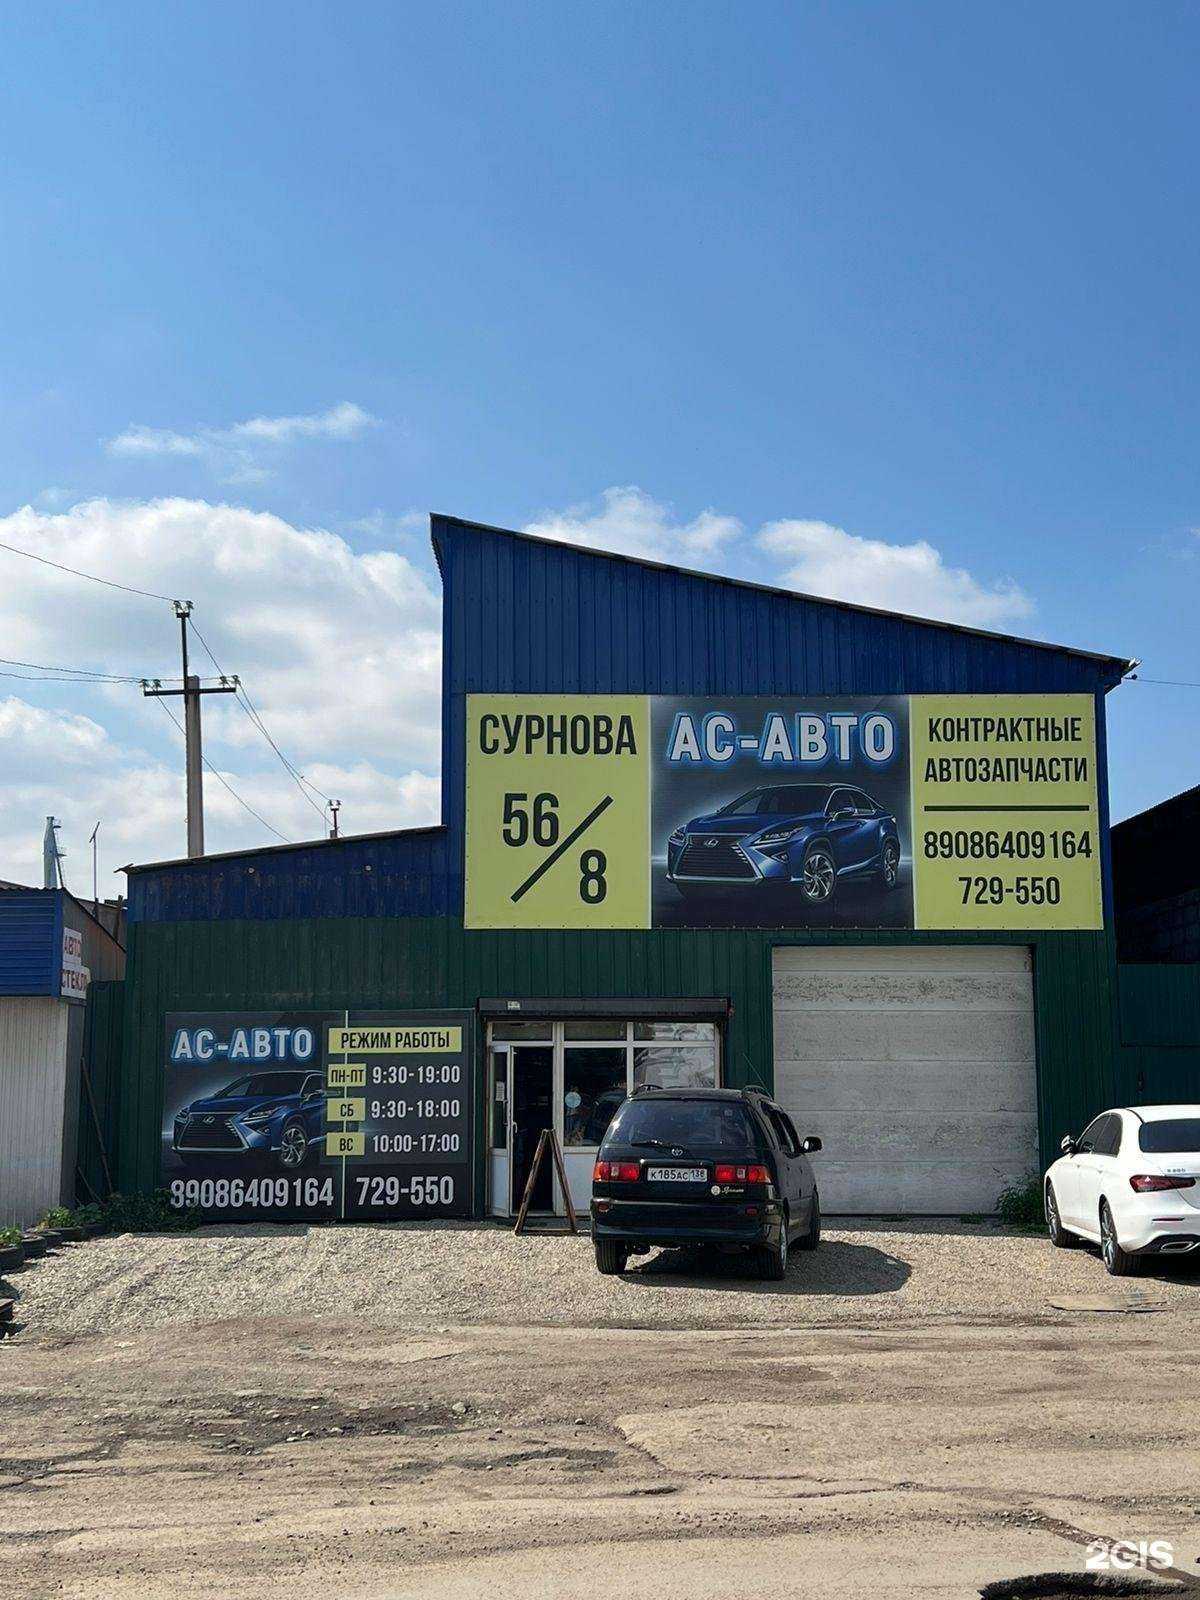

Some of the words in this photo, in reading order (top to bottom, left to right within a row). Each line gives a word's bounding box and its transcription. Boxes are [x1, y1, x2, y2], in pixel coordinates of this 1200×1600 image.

[479, 714, 638, 755] СУРНОВА
[669, 714, 895, 762] АС-АВТО
[928, 717, 1082, 742] КОНТРАКТНЫЕ
[924, 757, 1088, 782] АВТОЗАПЧАСТИ
[924, 830, 1092, 859] 89086409164
[958, 876, 1061, 905] 729-550
[173, 1028, 313, 1059] АС-АВТО
[341, 1032, 392, 1049] РЕЖИМ
[395, 1031, 450, 1048] РАБОТЫ
[330, 1068, 364, 1083] ПН-ПТ
[339, 1104, 354, 1117] СБ
[339, 1138, 354, 1152] ВС
[170, 1178, 335, 1208] 89086409164
[356, 1176, 454, 1206] 729-550
